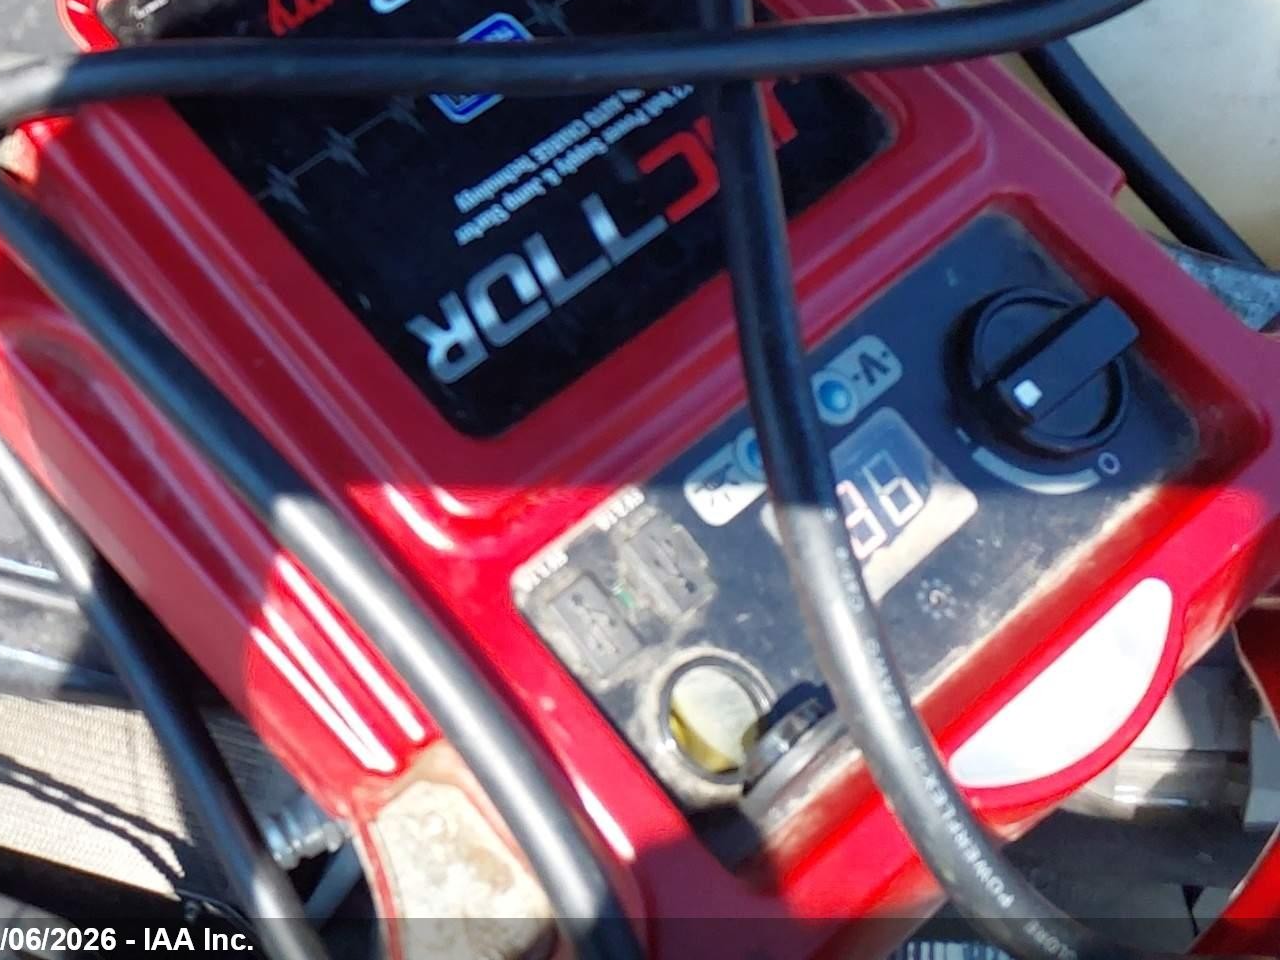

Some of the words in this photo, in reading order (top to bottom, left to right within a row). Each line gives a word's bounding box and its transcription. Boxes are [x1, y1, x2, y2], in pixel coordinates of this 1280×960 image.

[601, 107, 650, 146] Power
[553, 135, 609, 178] Supply
[502, 178, 547, 213] Jump
[456, 203, 510, 248] Starter
[923, 772, 1015, 907] POWERFLEX
